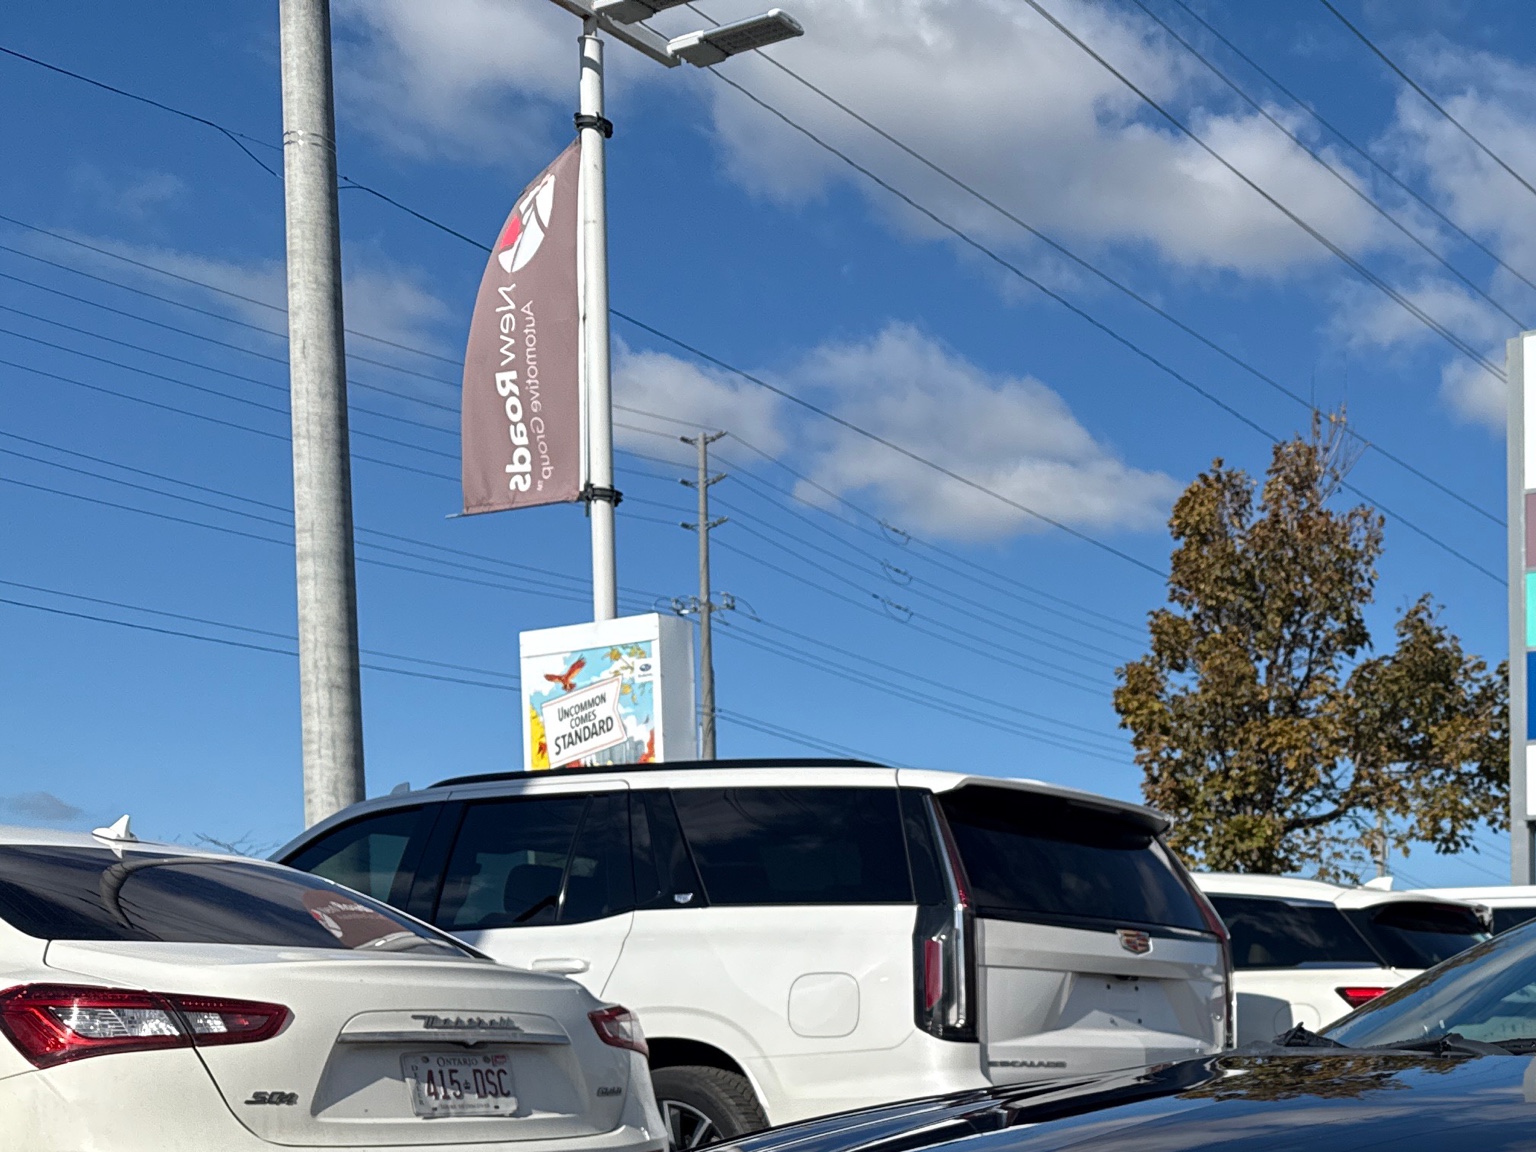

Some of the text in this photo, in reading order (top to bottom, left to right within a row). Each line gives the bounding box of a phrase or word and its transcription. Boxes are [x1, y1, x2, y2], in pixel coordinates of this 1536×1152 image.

[570, 709, 597, 730] COMES
[554, 716, 615, 755] STANDARD
[436, 1056, 478, 1067] ONTARIO
[426, 1068, 511, 1100] 415 DSC
